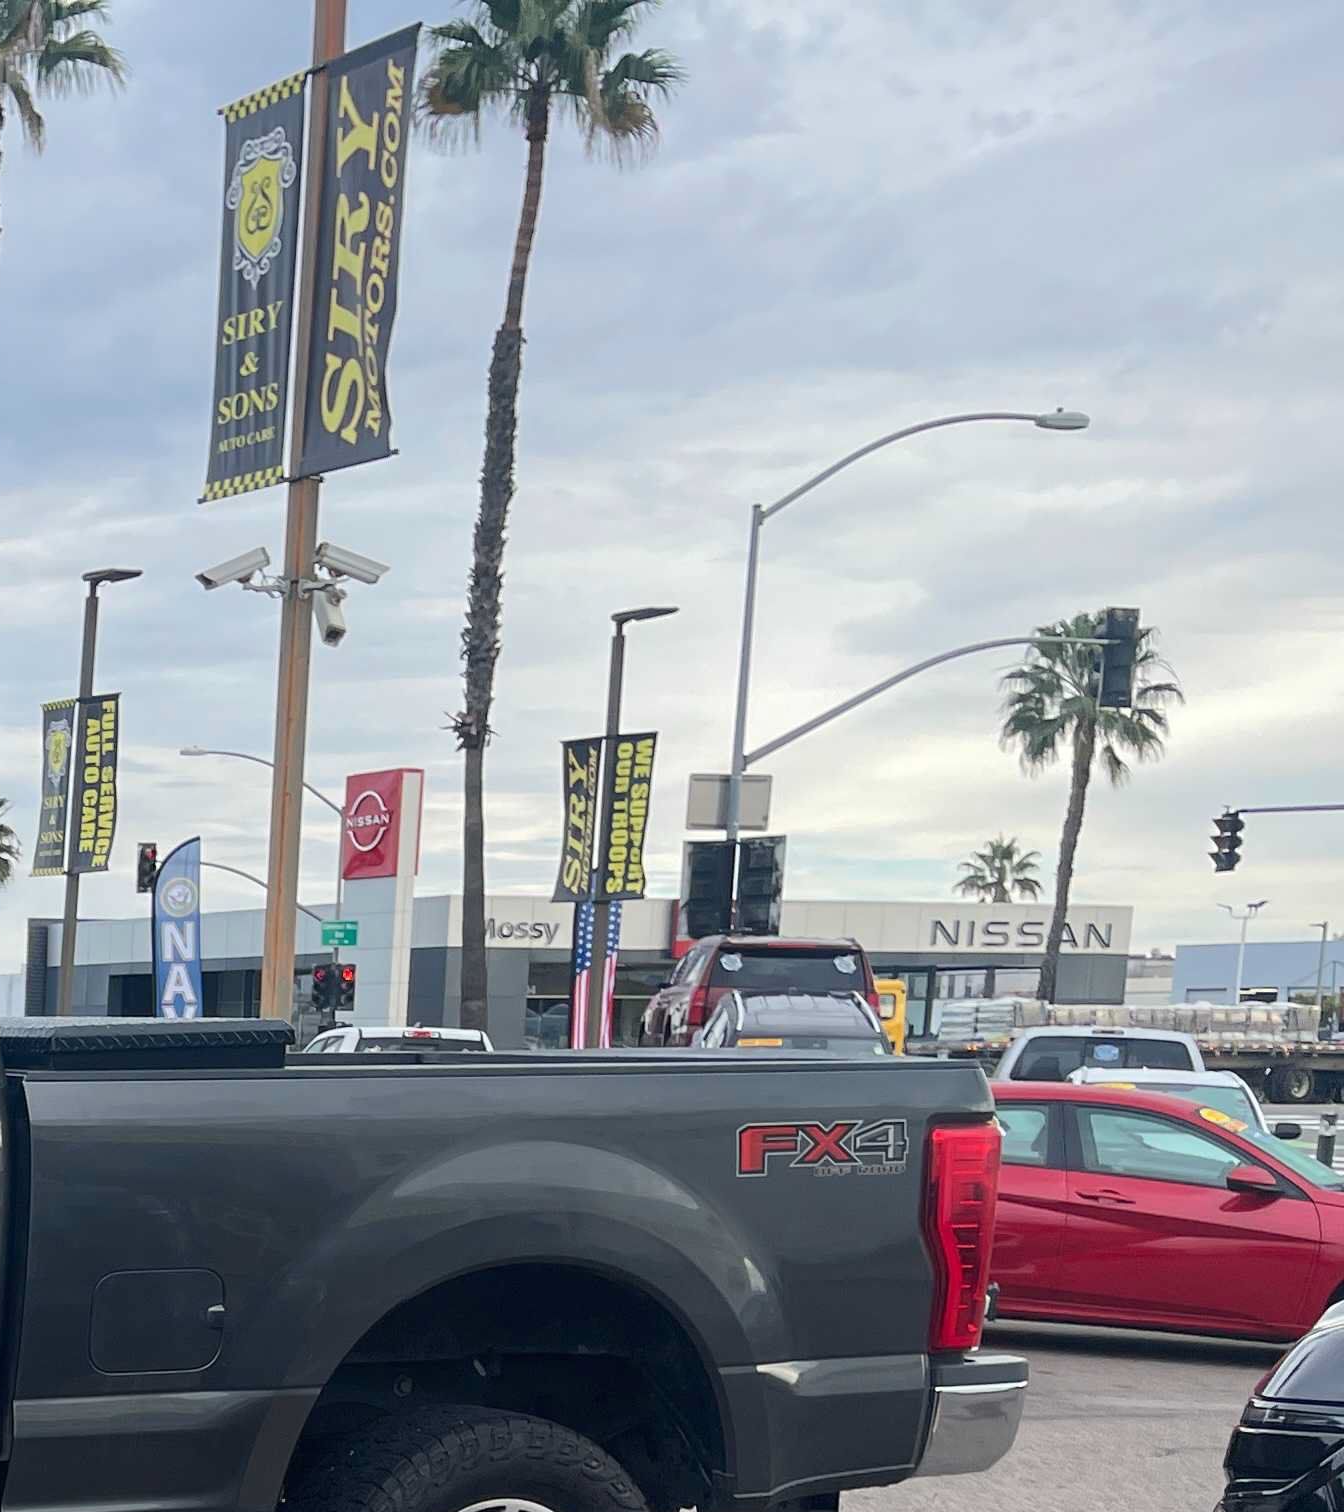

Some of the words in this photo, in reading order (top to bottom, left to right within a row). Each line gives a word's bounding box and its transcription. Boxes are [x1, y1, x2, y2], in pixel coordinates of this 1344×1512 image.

[321, 75, 380, 445] SIRY
[364, 58, 405, 438] MOTORS.COM
[222, 301, 283, 345] SIRY
[239, 351, 259, 377] &
[217, 383, 279, 425] SONS
[84, 718, 101, 784] AUTO
[101, 700, 116, 756] FULL
[615, 742, 634, 793] OUR
[634, 738, 654, 778] WE
[79, 789, 98, 853] CARE
[91, 765, 114, 867] SERVICE
[346, 813, 390, 828] NISSAN
[563, 747, 588, 894] SIRY
[606, 797, 629, 894] TROOPS
[626, 783, 649, 894] SUPPORT
[930, 919, 1113, 949] NISSAN
[736, 1118, 910, 1177] FX4
